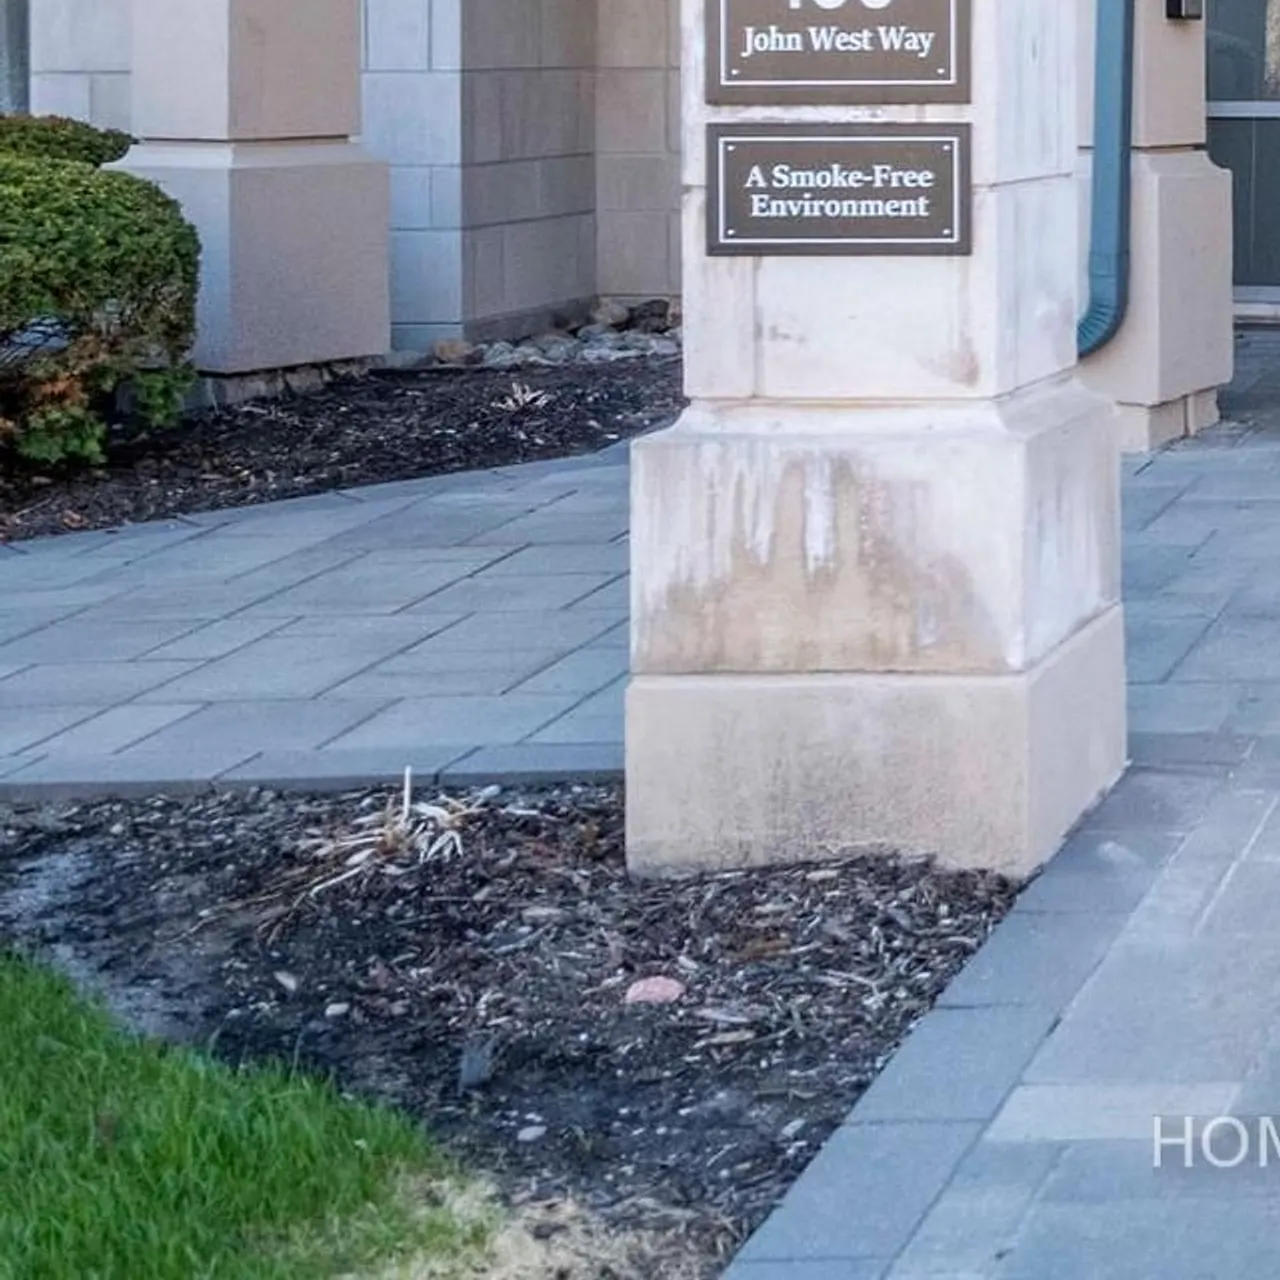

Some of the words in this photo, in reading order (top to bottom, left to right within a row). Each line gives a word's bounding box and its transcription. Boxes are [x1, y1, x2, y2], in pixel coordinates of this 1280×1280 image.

[741, 26, 802, 57] John
[810, 27, 872, 52] West
[877, 27, 935, 57] Way
[745, 166, 766, 188] A
[772, 165, 934, 189] Smoke-Free
[751, 193, 929, 218] Environment
